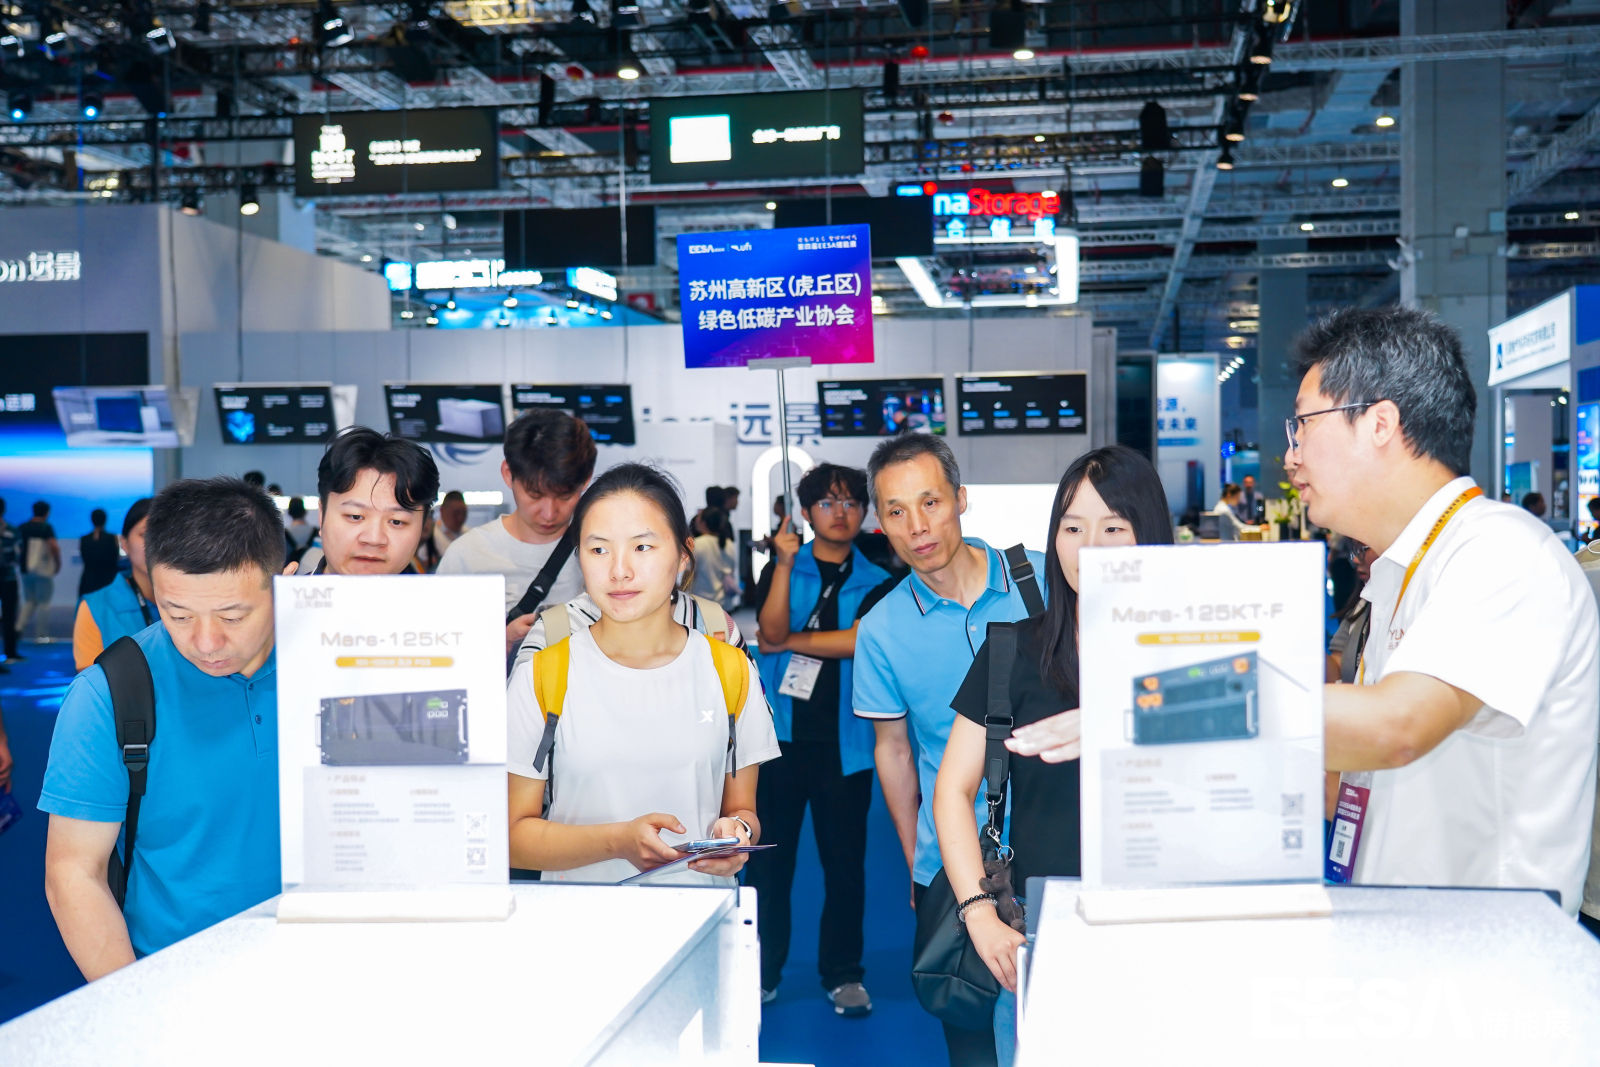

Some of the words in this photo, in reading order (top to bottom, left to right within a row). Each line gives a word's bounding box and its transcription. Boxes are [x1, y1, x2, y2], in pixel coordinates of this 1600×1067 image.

[698, 303, 855, 331] 绿色低碳产业协会
[292, 586, 335, 600] YUNT
[1111, 602, 1284, 624] Mars-125KT-F
[320, 631, 464, 647] Mars-125KT
